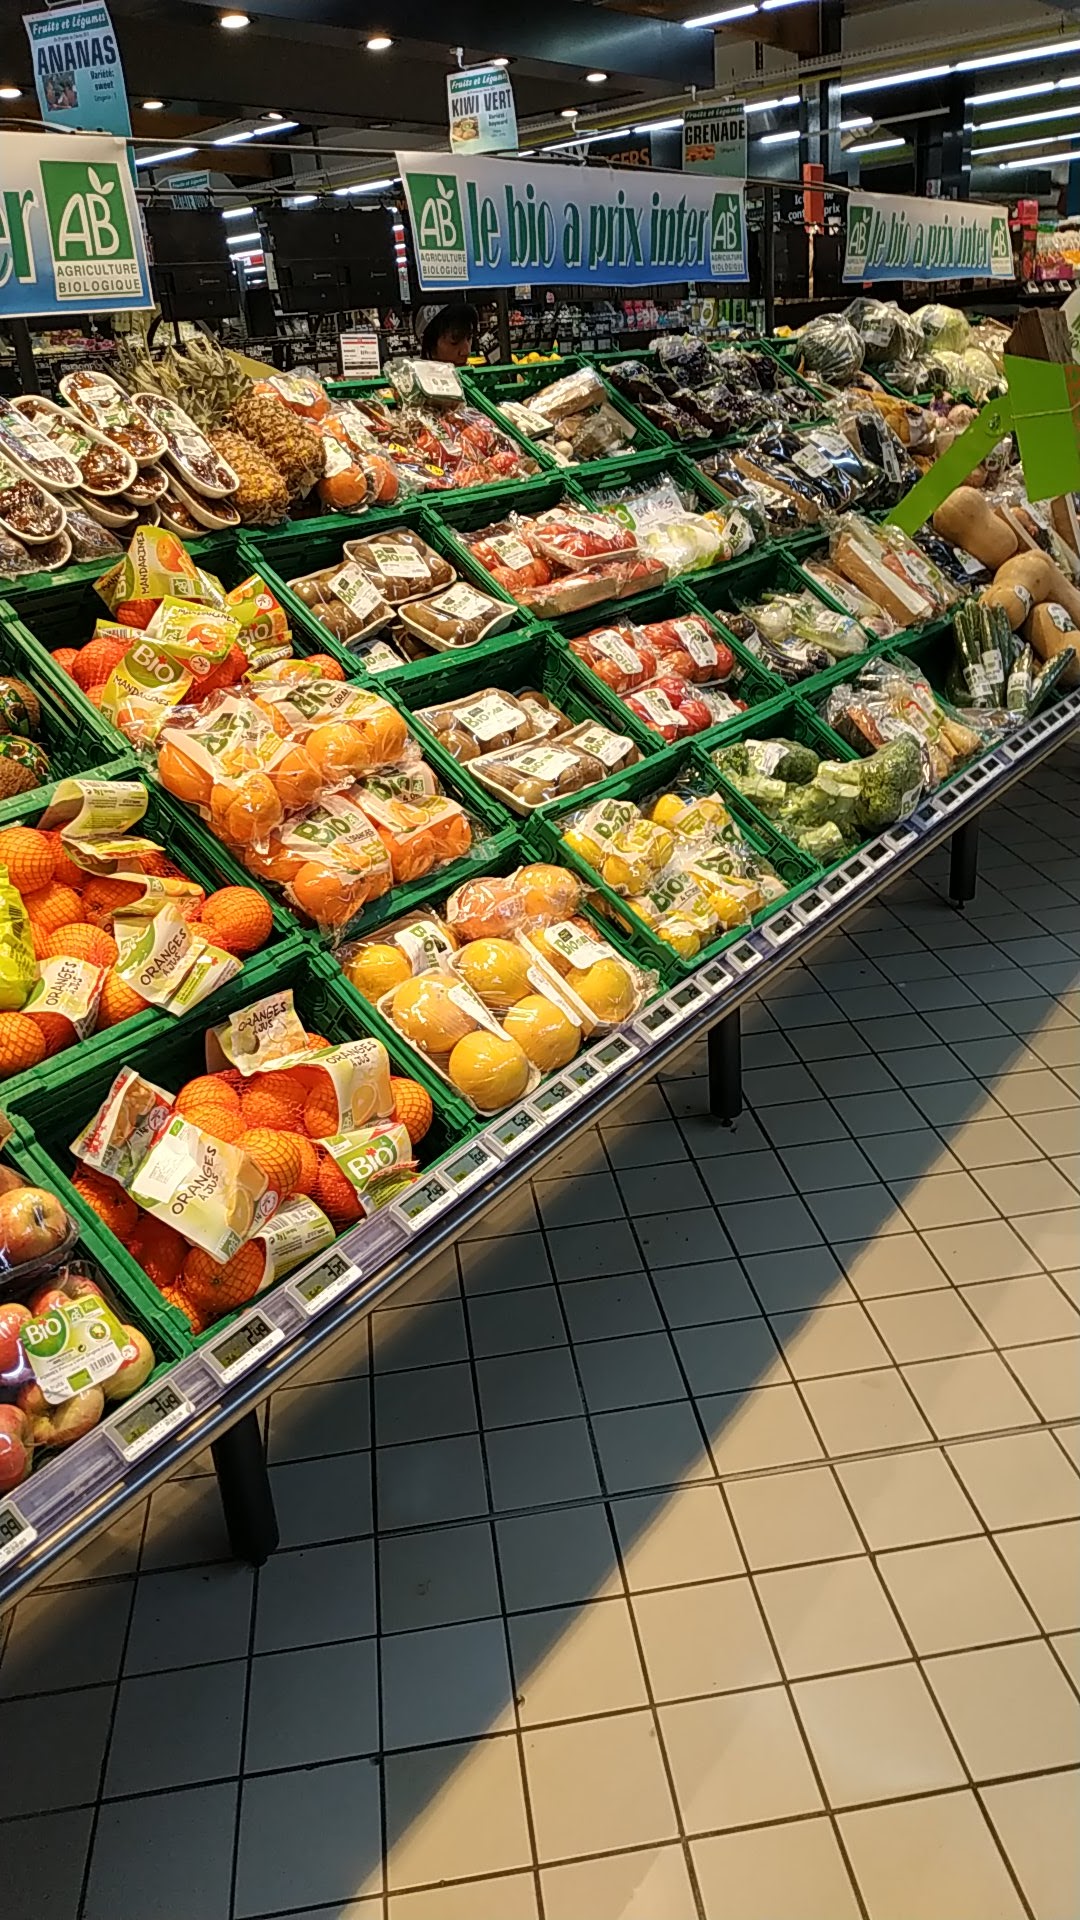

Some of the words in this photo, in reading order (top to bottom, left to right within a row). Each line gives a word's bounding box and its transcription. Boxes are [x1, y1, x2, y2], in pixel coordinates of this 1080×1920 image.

[33, 22, 59, 35] Fruits
[61, 19, 70, 29] et
[72, 13, 106, 29] Légumes
[37, 35, 117, 76] ANANAS
[94, 81, 114, 91] sweet
[452, 79, 472, 90] Fruits
[473, 77, 481, 85] et
[452, 95, 480, 117] KIWI
[484, 89, 511, 112] VERT
[684, 120, 746, 146] GRENADE
[420, 197, 457, 247] AB
[823, 203, 841, 218] prix
[58, 192, 121, 257] AB
[466, 181, 501, 269] le
[504, 182, 557, 269] bio
[563, 201, 583, 268] a
[588, 189, 644, 271] prix
[650, 191, 710, 267] inter
[712, 211, 738, 250] AB
[848, 221, 868, 255] AB
[867, 210, 887, 268] le
[885, 210, 912, 268] bio
[925, 214, 955, 270] prix
[957, 215, 990, 268] inter
[992, 229, 1007, 257] AB
[57, 262, 138, 278] AGRICULTURE
[420, 252, 467, 263] AGRICULTURE
[422, 265, 467, 275] BIOLOGIQUE
[711, 253, 743, 261] AGRICULTURE
[58, 278, 141, 294] BIOLOGIQUE
[136, 531, 150, 595] MANDARINES
[237, 622, 270, 648] BIO
[131, 643, 175, 683] BIO
[140, 928, 187, 986] ORANGES
[46, 961, 78, 1006] ORANGES
[238, 1001, 288, 1032] ORANGES
[258, 1019, 274, 1033] JUS
[325, 1041, 377, 1065] ORANGES
[347, 1147, 396, 1180] BIO
[171, 1145, 217, 1216] ORANGES
[205, 1173, 220, 1196] JUS
[25, 1318, 62, 1346] BIO
[239, 1323, 267, 1346] 249
[148, 1393, 177, 1418] 349
[0, 1518, 17, 1538] 99
